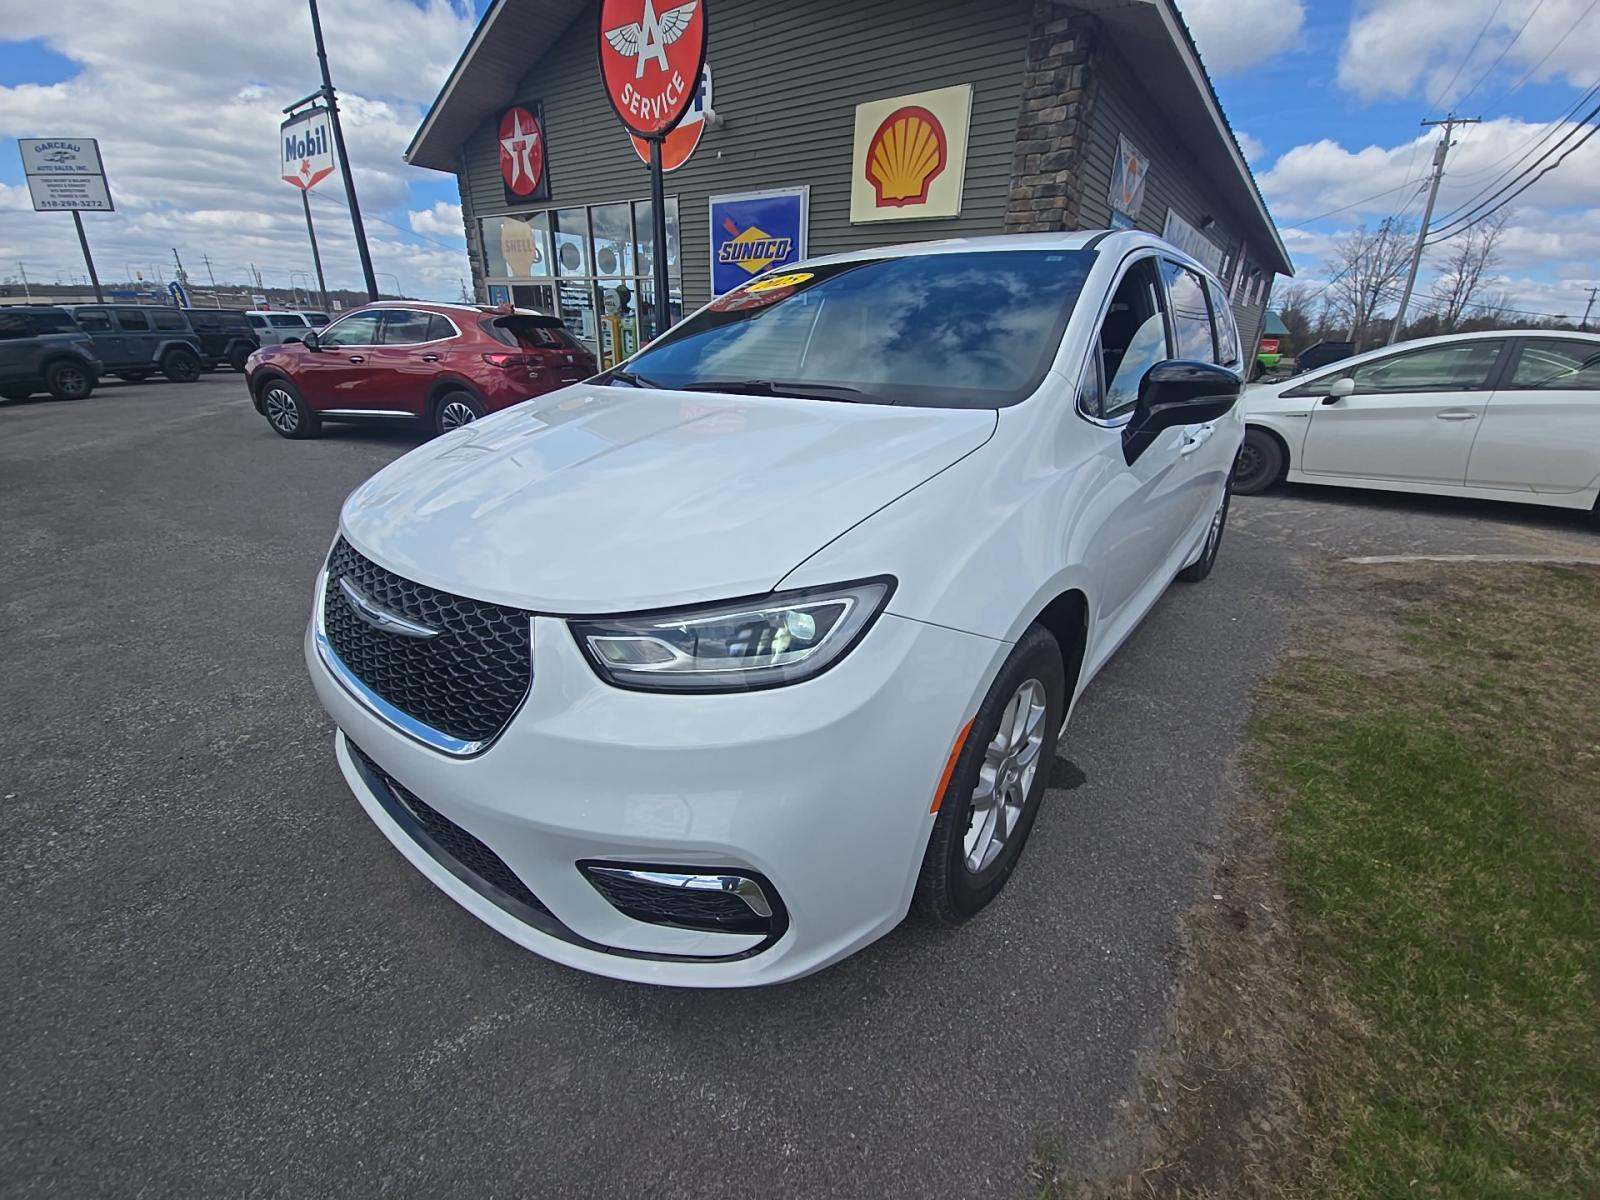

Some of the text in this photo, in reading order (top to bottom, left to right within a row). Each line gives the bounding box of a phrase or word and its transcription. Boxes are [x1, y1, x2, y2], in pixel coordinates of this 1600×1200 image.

[621, 70, 685, 119] SERVICE
[35, 142, 80, 153] GARCEAU
[285, 125, 327, 161] Mobil
[505, 239, 532, 252] SHELL
[720, 240, 790, 260] SUNOCO
